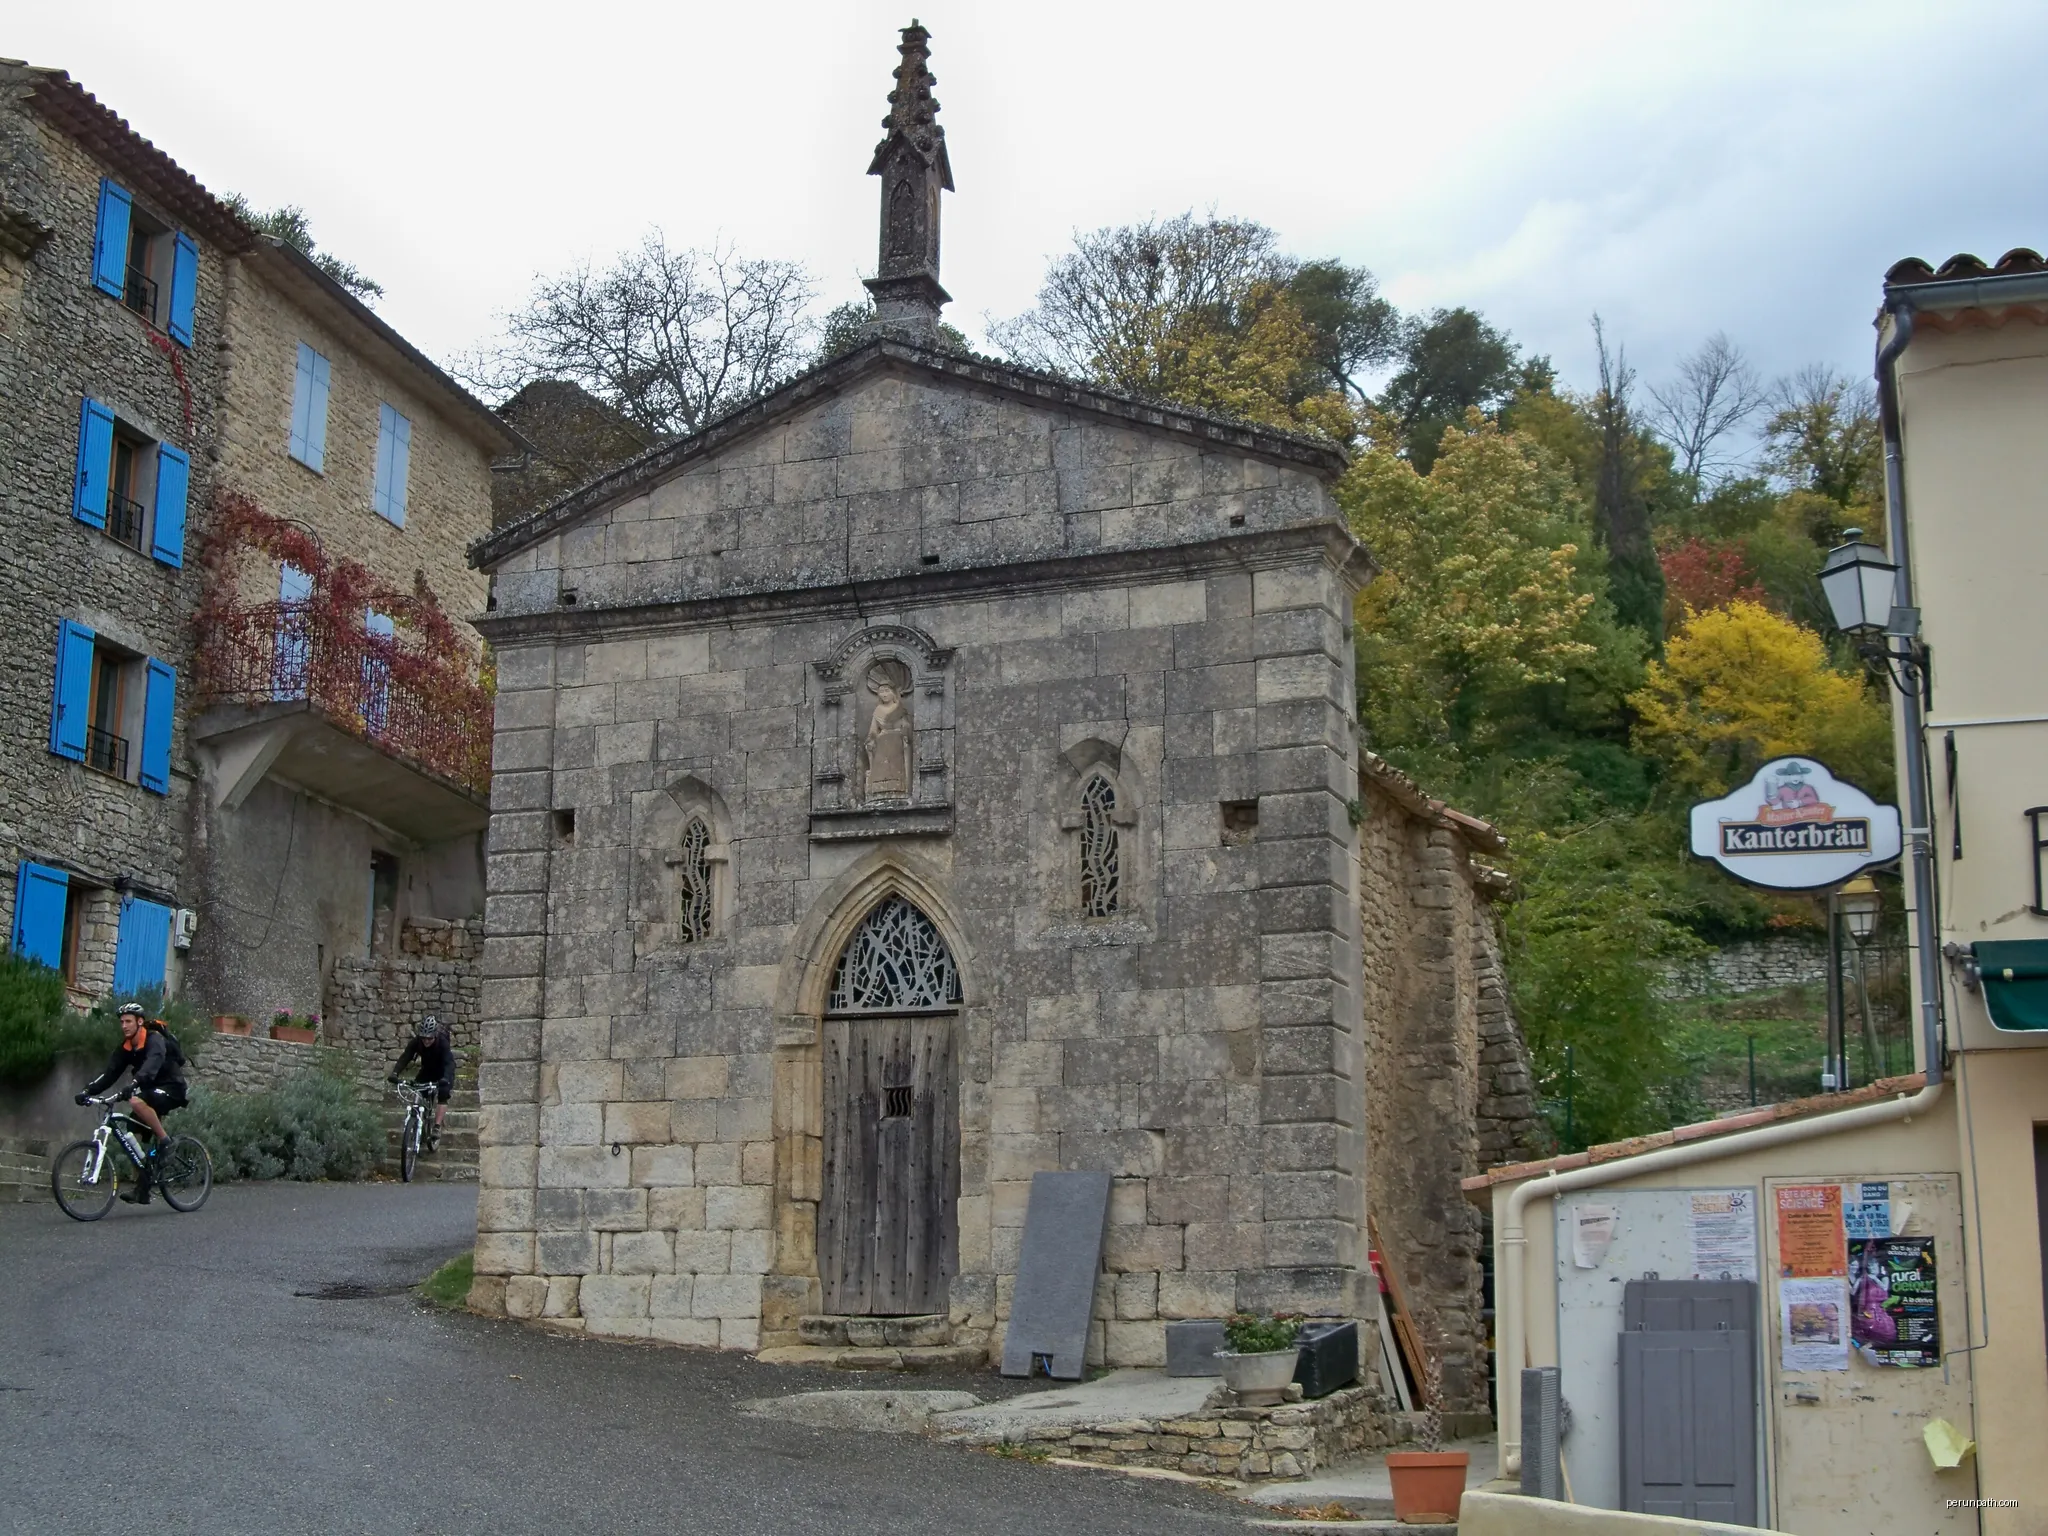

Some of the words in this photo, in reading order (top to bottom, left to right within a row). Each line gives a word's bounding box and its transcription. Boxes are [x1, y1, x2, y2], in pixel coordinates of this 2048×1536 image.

[1725, 824, 1866, 850] Kanterbräu
[1780, 1188, 1799, 1199] FÊTE
[1800, 1190, 1812, 1198] DE
[1813, 1189, 1824, 1198] LA
[1780, 1199, 1825, 1209] SCIENCE
